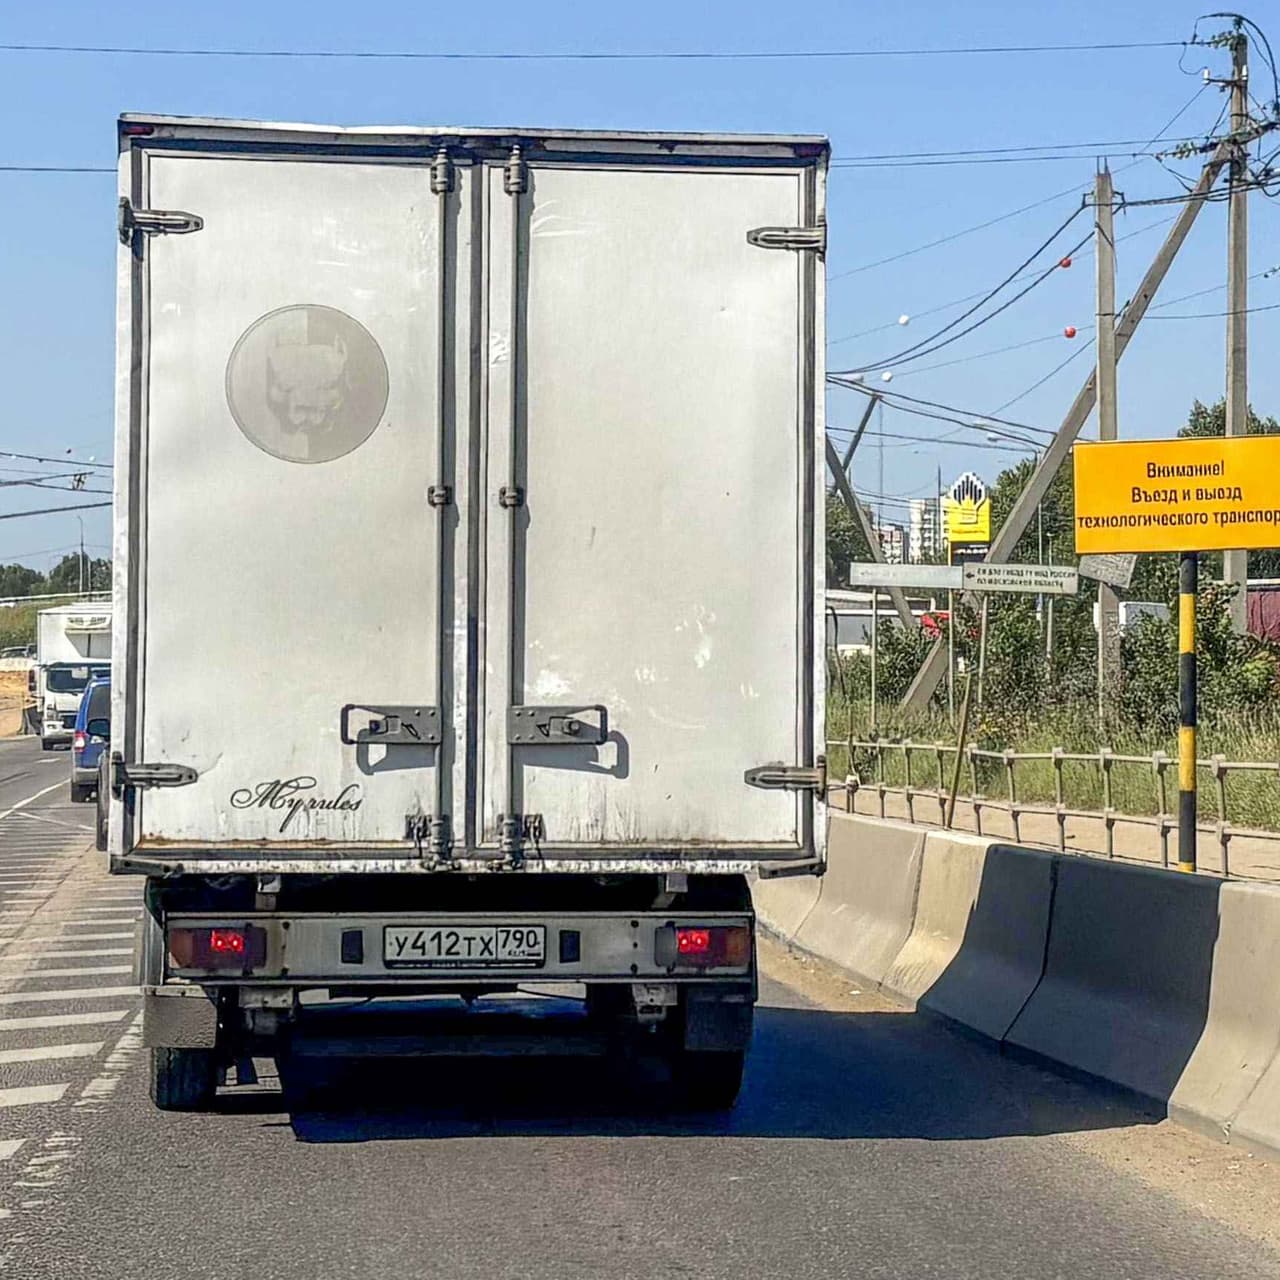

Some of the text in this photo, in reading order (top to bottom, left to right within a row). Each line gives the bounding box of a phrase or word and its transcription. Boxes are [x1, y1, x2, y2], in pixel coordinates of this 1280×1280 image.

[1146, 460, 1225, 478] Внимание!
[1131, 486, 1242, 504] Въезд и выезд
[1078, 511, 1209, 529] технологического
[394, 929, 538, 957] У412ТХ 790
